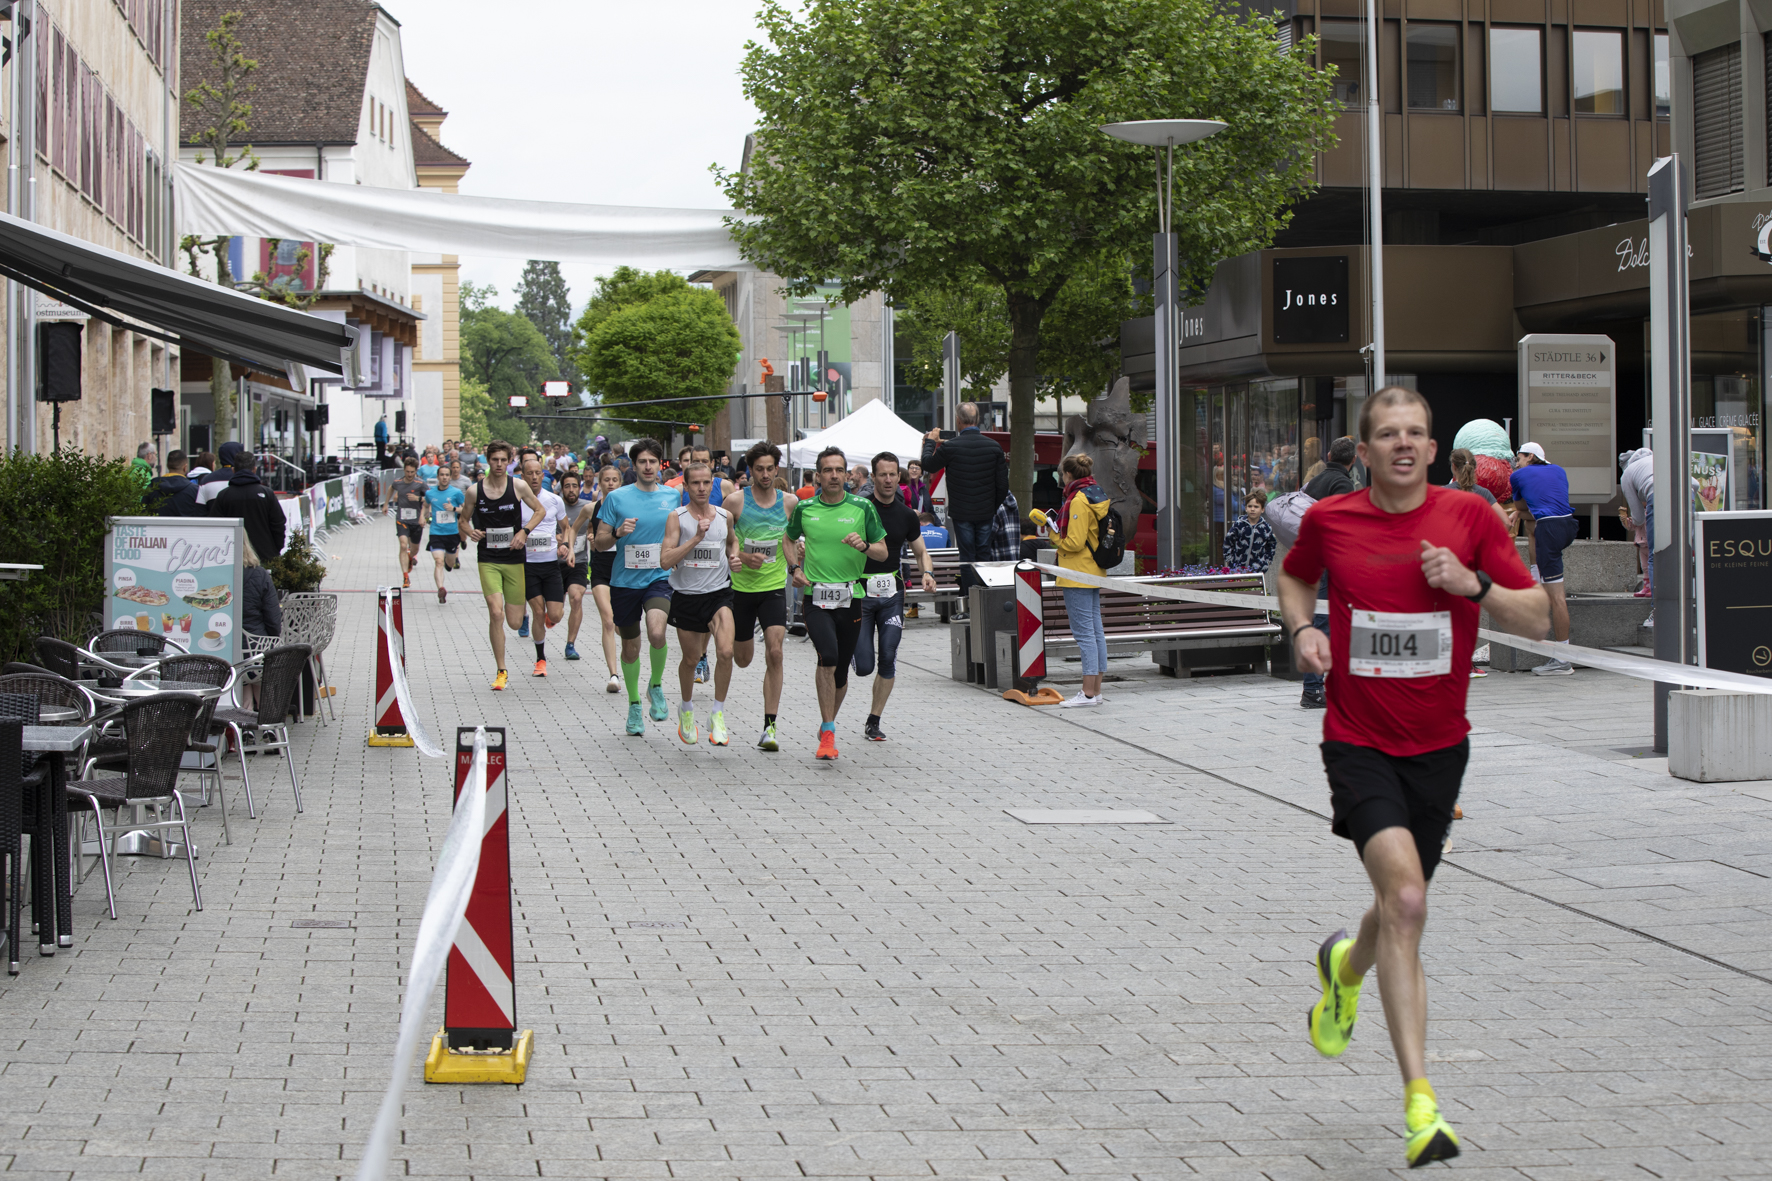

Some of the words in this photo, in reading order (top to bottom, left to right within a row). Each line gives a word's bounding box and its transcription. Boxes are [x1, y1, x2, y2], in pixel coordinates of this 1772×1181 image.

[1615, 236, 1650, 273] Dolc
[1282, 289, 1338, 311] Jones
[1179, 311, 1204, 345] Jones
[1534, 351, 1582, 362] STÄDTLE
[1585, 352, 1597, 363] 36
[1698, 416, 1716, 428] GLACE
[1691, 464, 1722, 477] NUSS
[114, 525, 147, 537] TASTE
[114, 537, 128, 549] OF
[129, 537, 168, 549] ITALIAN
[491, 534, 509, 542] 1008
[531, 538, 548, 547] 1062
[114, 548, 142, 560] FOOD
[635, 550, 650, 559] 848
[693, 549, 712, 560] 1001
[876, 579, 891, 589] 833
[820, 590, 841, 601] 1143
[1370, 632, 1418, 656] 1014
